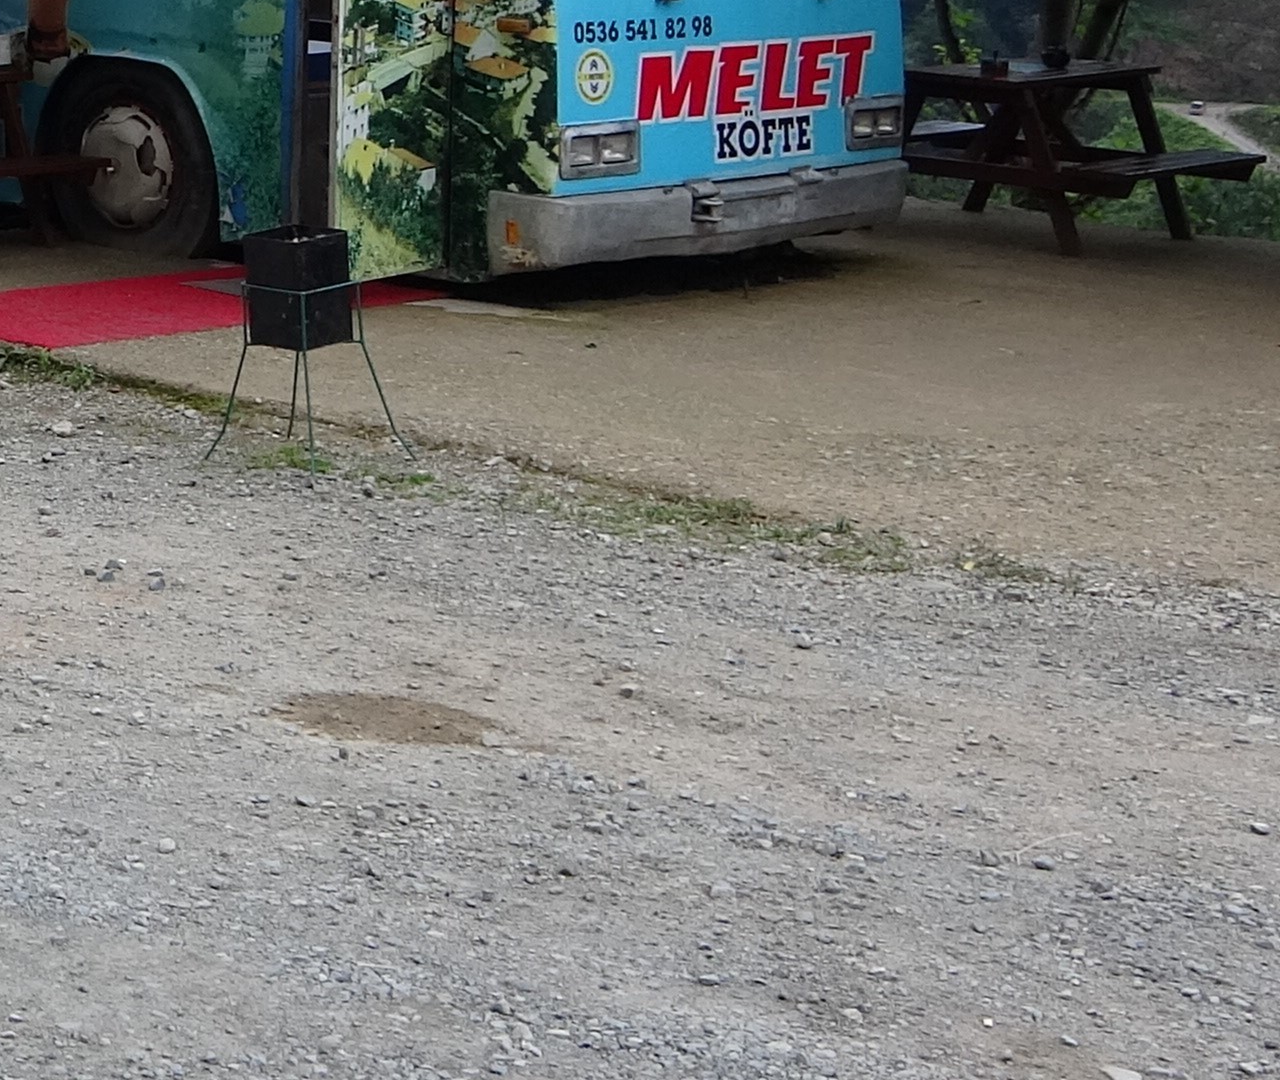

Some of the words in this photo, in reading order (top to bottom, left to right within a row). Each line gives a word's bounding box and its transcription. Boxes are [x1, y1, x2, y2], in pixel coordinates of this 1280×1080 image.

[573, 21, 619, 44] 0536
[625, 18, 657, 42] 541
[665, 16, 687, 41] 82
[691, 15, 713, 39] 98
[637, 33, 874, 122] MELET
[716, 110, 812, 157] KÖFTE
